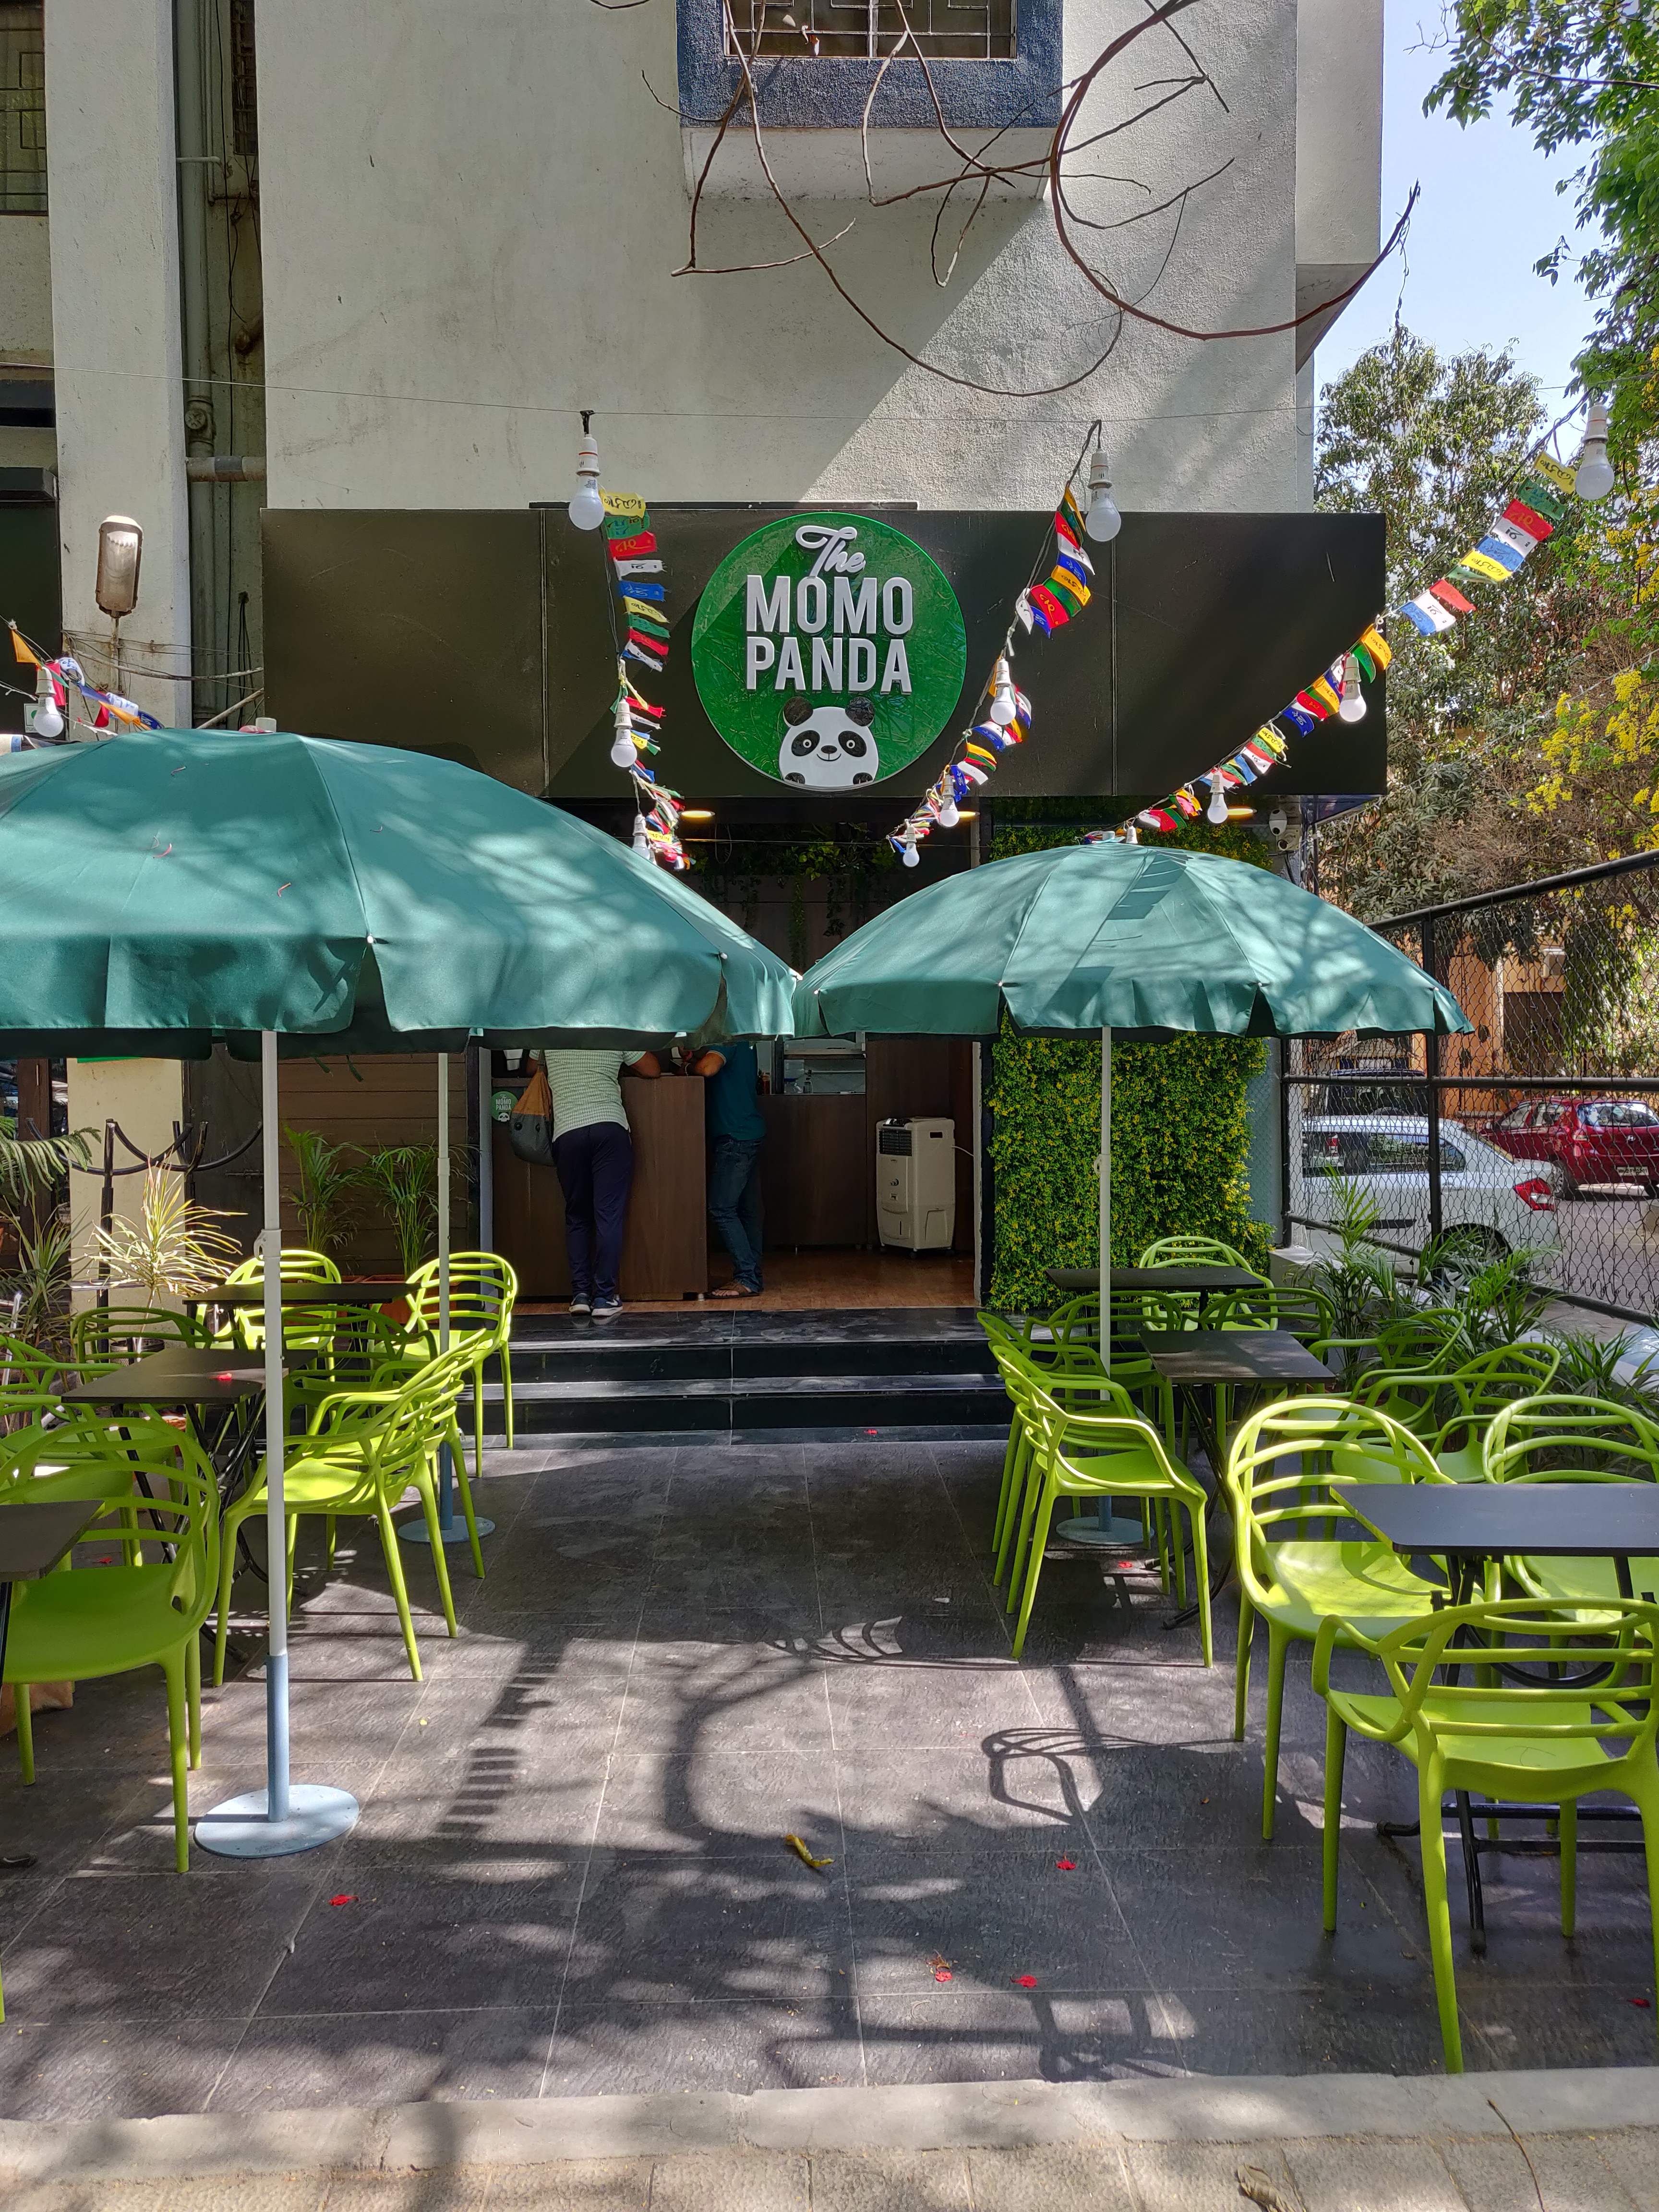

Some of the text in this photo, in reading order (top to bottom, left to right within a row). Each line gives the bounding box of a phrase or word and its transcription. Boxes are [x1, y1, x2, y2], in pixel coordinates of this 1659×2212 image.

[795, 525, 866, 577] The
[746, 575, 913, 635] MOMO
[746, 636, 912, 695] PANDA
